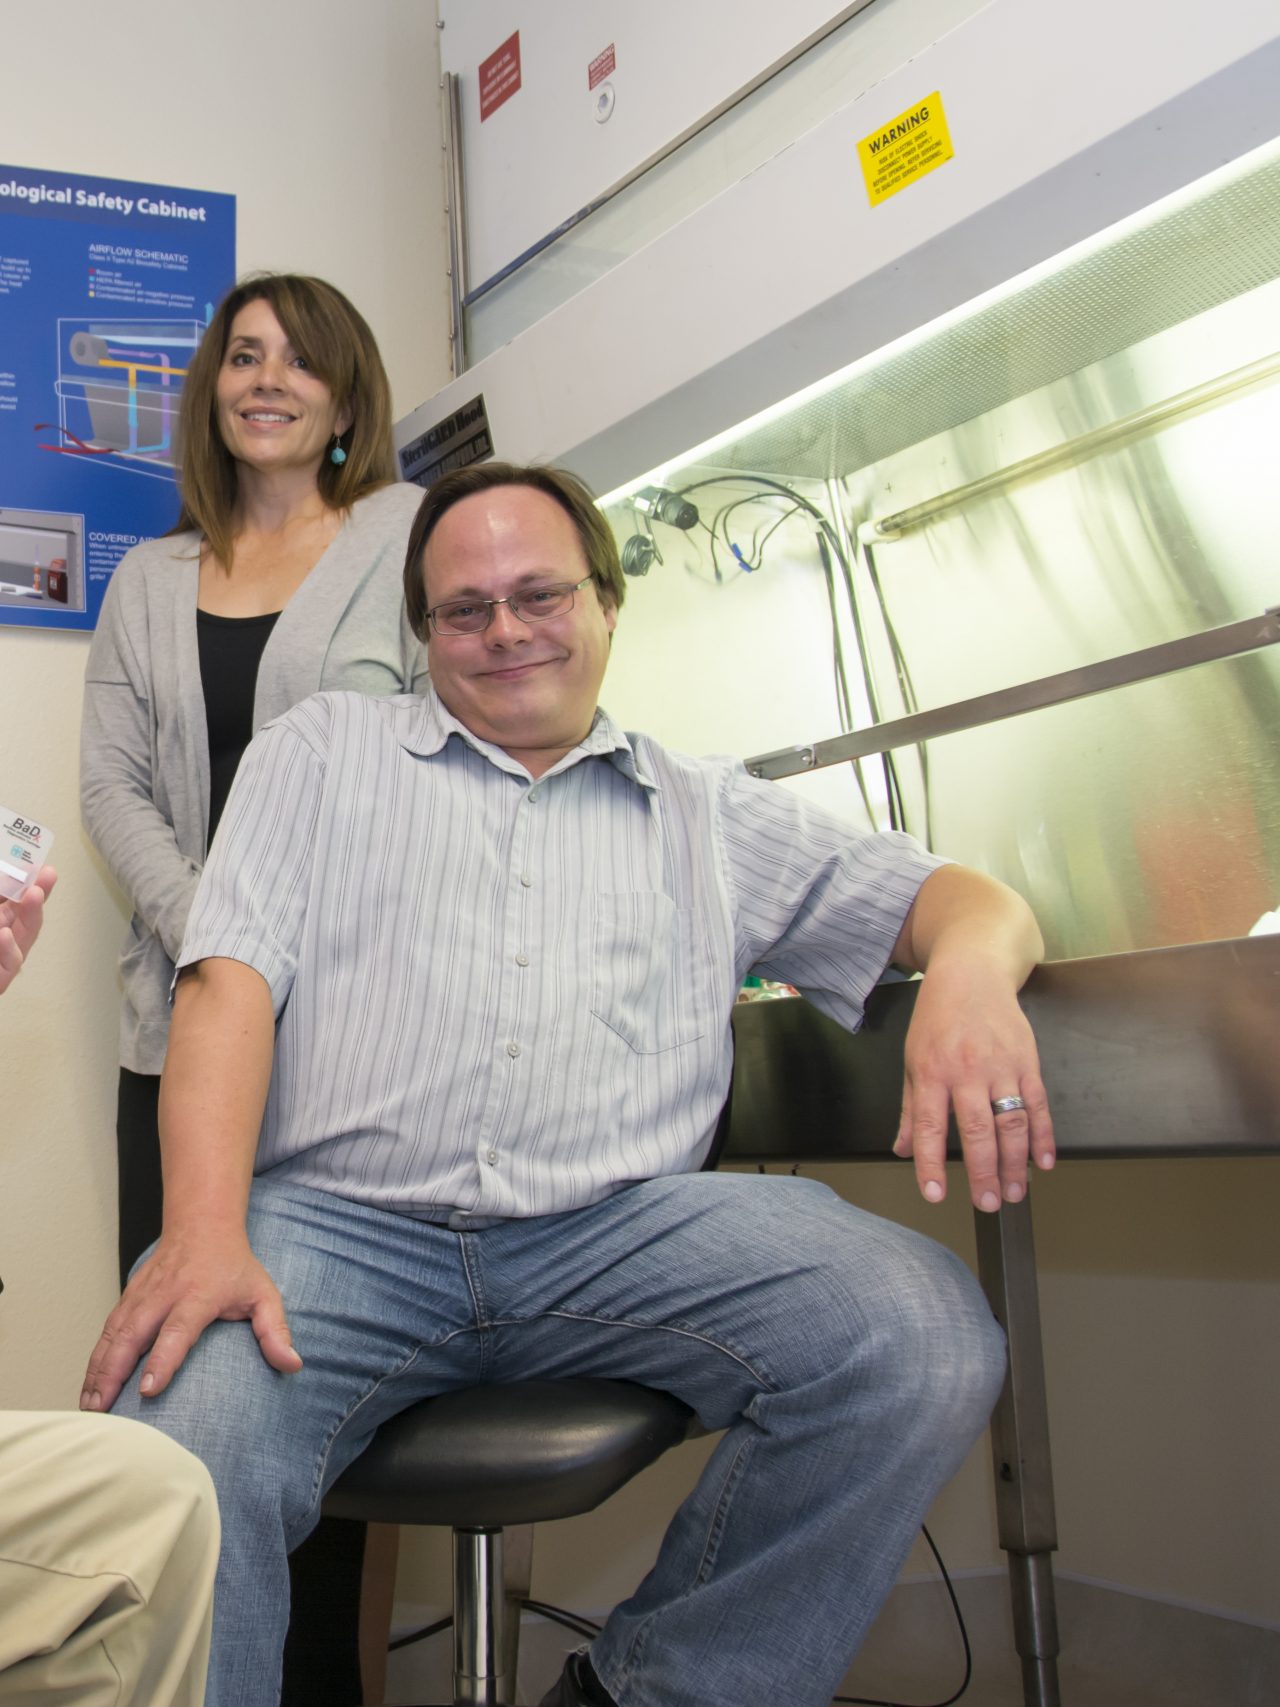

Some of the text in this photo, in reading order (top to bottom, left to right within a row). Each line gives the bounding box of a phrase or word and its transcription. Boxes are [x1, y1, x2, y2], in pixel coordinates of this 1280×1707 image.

[869, 107, 929, 154] WARNING
[75, 190, 133, 215] Safety
[137, 198, 207, 222] Cabinet
[89, 244, 188, 264] AIRFLOW SCHEMATIC
[89, 532, 137, 544] COVERED
